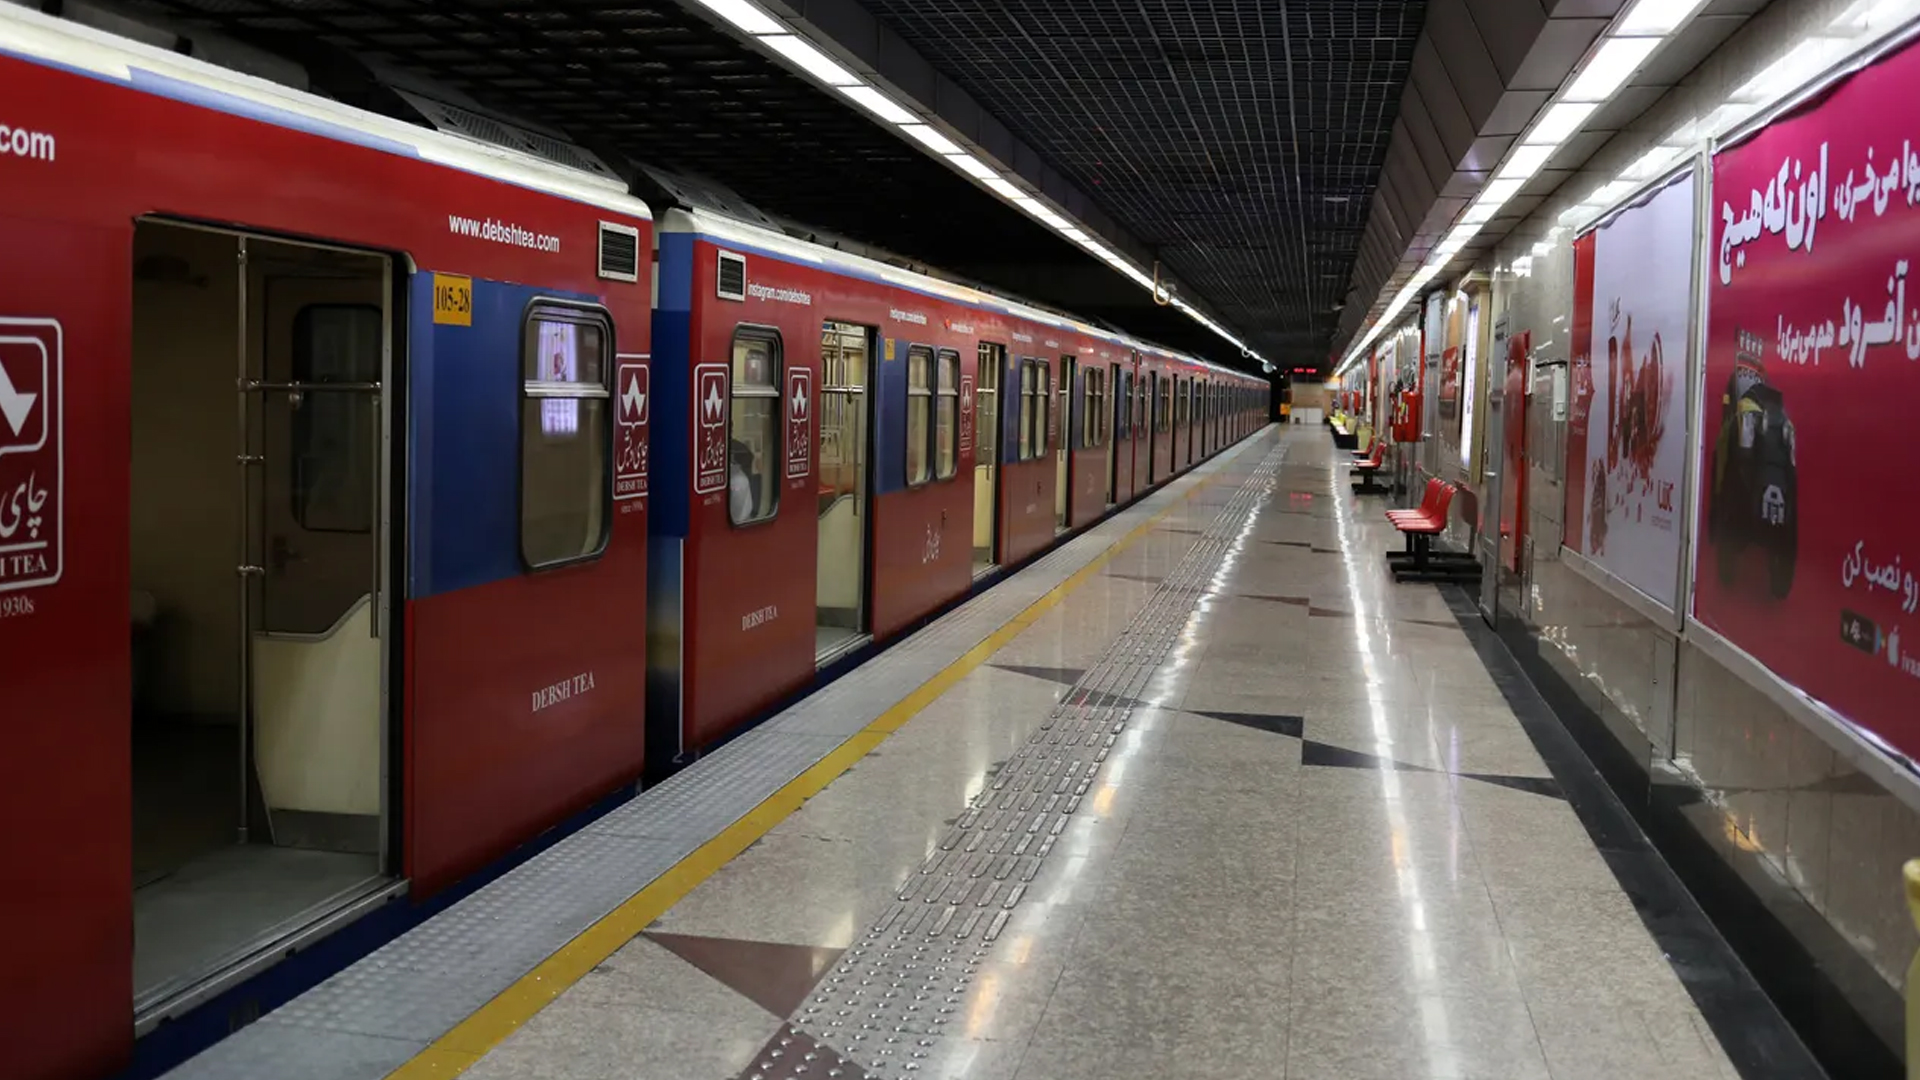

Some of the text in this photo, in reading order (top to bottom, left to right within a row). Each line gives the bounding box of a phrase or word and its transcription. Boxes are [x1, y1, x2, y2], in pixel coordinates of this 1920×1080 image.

[448, 214, 560, 253] www.debshtea.com
[1719, 189, 1763, 285] هیچ
[436, 285, 470, 313] 105-28
[1839, 259, 1909, 368] آفرود
[11, 553, 47, 576] TEA
[1843, 540, 1864, 588] کن
[1864, 555, 1900, 592] نصب
[531, 670, 595, 712] DEBSH TEA
